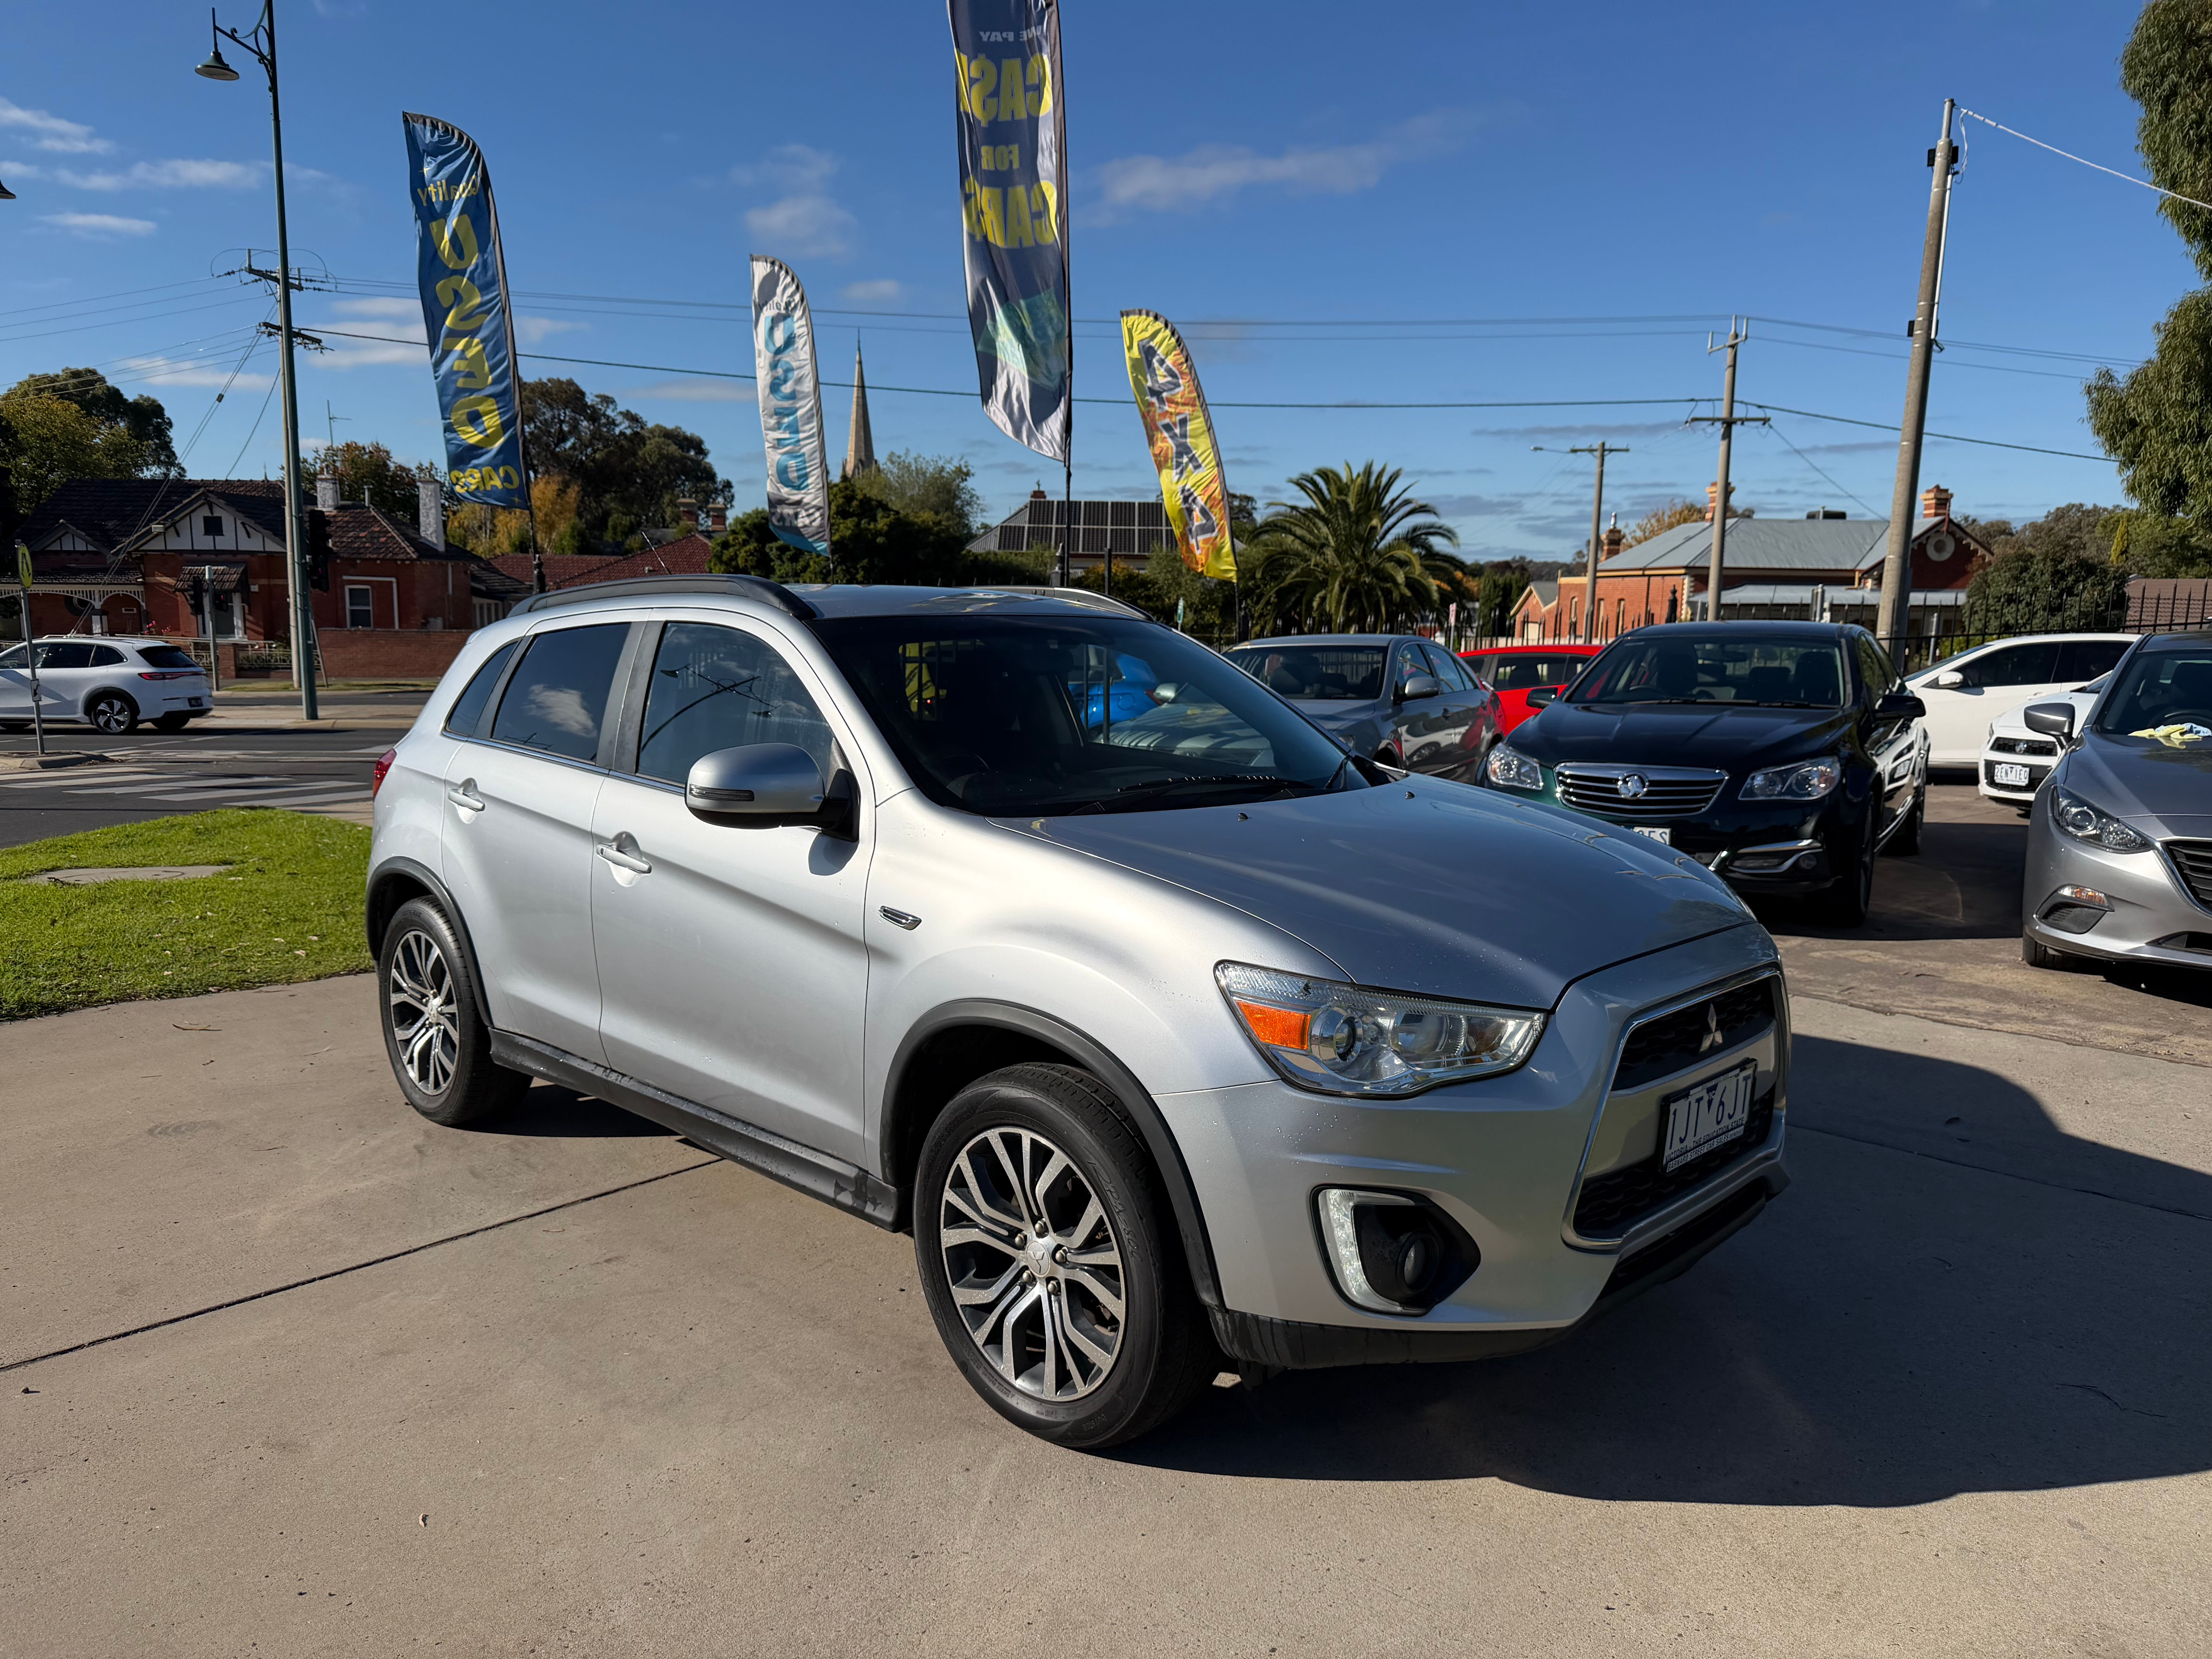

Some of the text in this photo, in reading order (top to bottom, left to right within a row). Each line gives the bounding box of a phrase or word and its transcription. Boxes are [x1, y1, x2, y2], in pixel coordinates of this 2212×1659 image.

[1669, 1073, 1751, 1150] 1JT 6JT
[1707, 1090, 1716, 1100] VIC
[1666, 1145, 1688, 1161] VICTORIA
[1693, 1137, 1702, 1147] THE
[1703, 1123, 1729, 1142] EDUCATION
[1731, 1117, 1744, 1129] STATE
[1668, 1154, 1689, 1171] BARNARD
[1689, 1145, 1706, 1159] STREET
[1706, 1141, 1715, 1150] CAR
[1716, 1134, 1729, 1146] SALES
